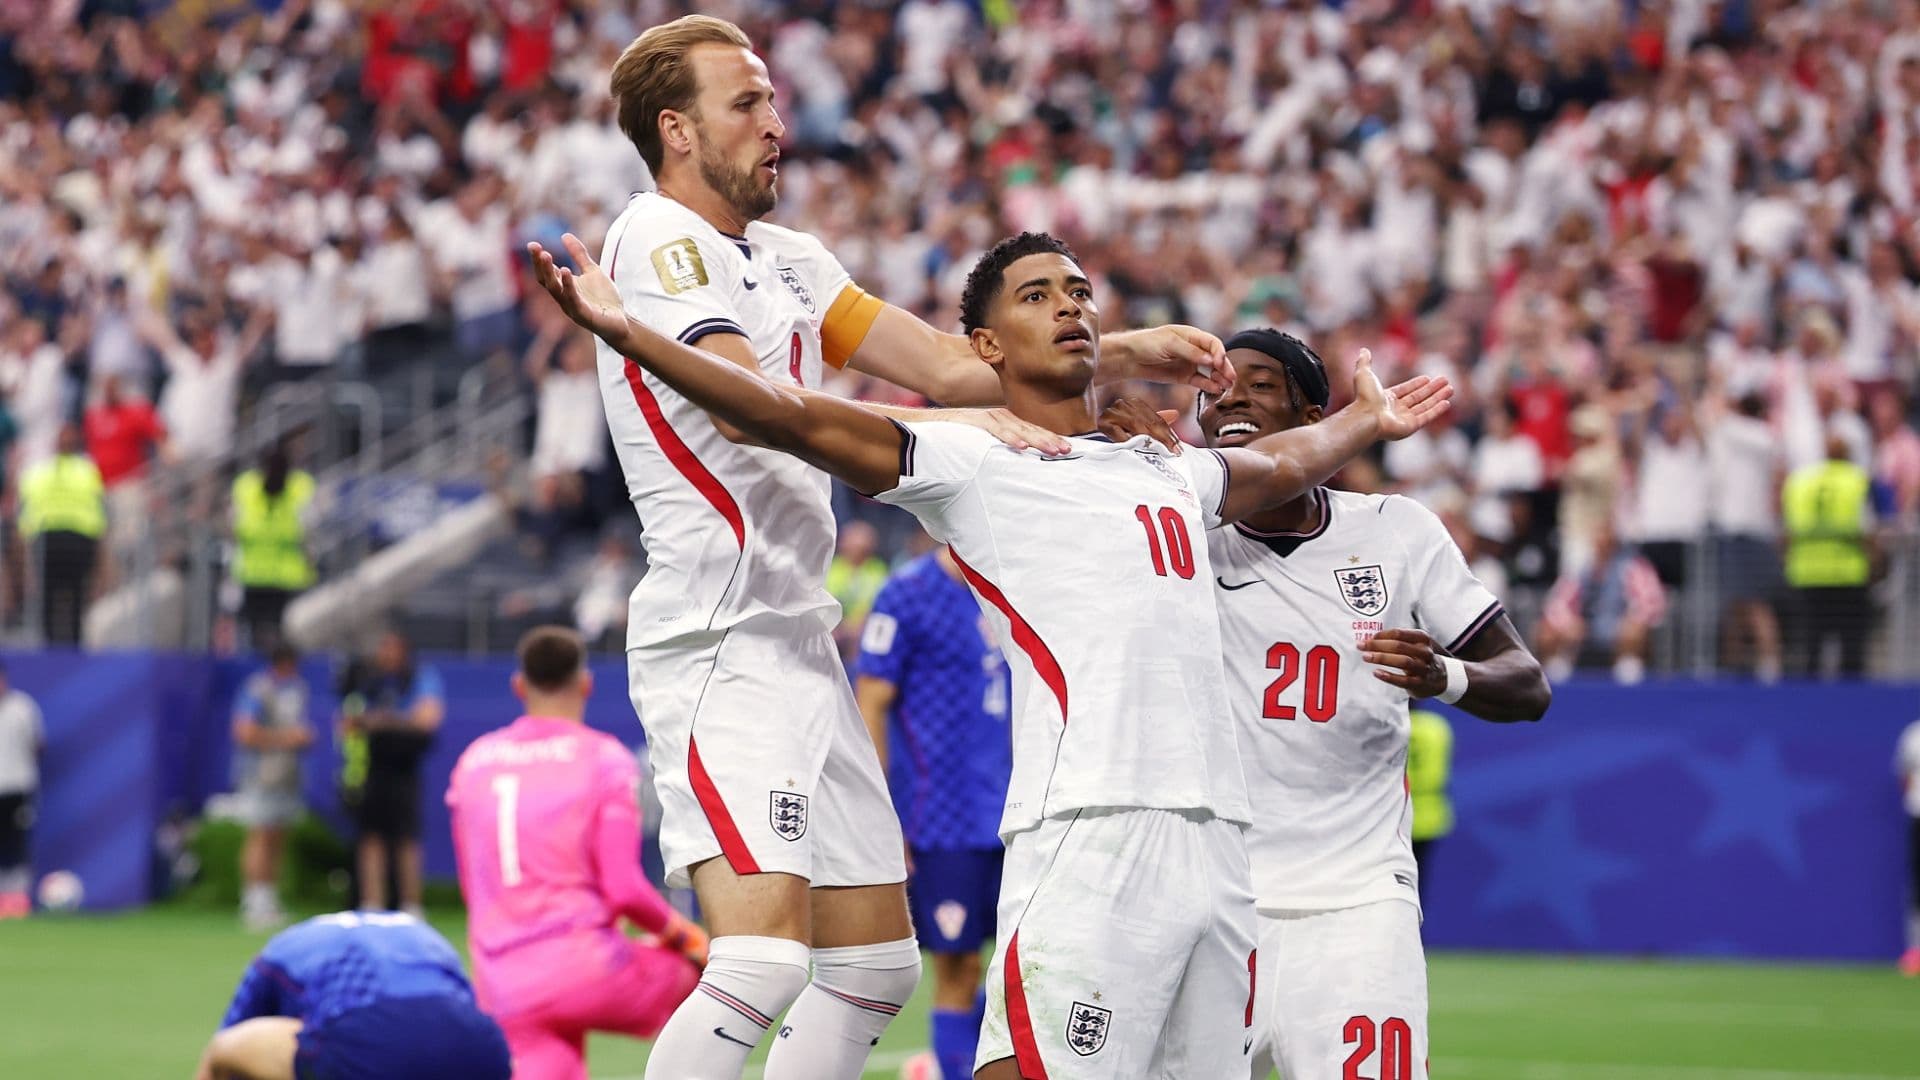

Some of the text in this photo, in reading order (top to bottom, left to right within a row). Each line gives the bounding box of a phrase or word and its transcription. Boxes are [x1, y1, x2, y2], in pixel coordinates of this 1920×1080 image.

[1134, 504, 1195, 580] 10
[1352, 620, 1383, 631] CROATIA
[1262, 641, 1340, 723] 20
[491, 773, 522, 887] 1
[1342, 1014, 1412, 1080] 20
